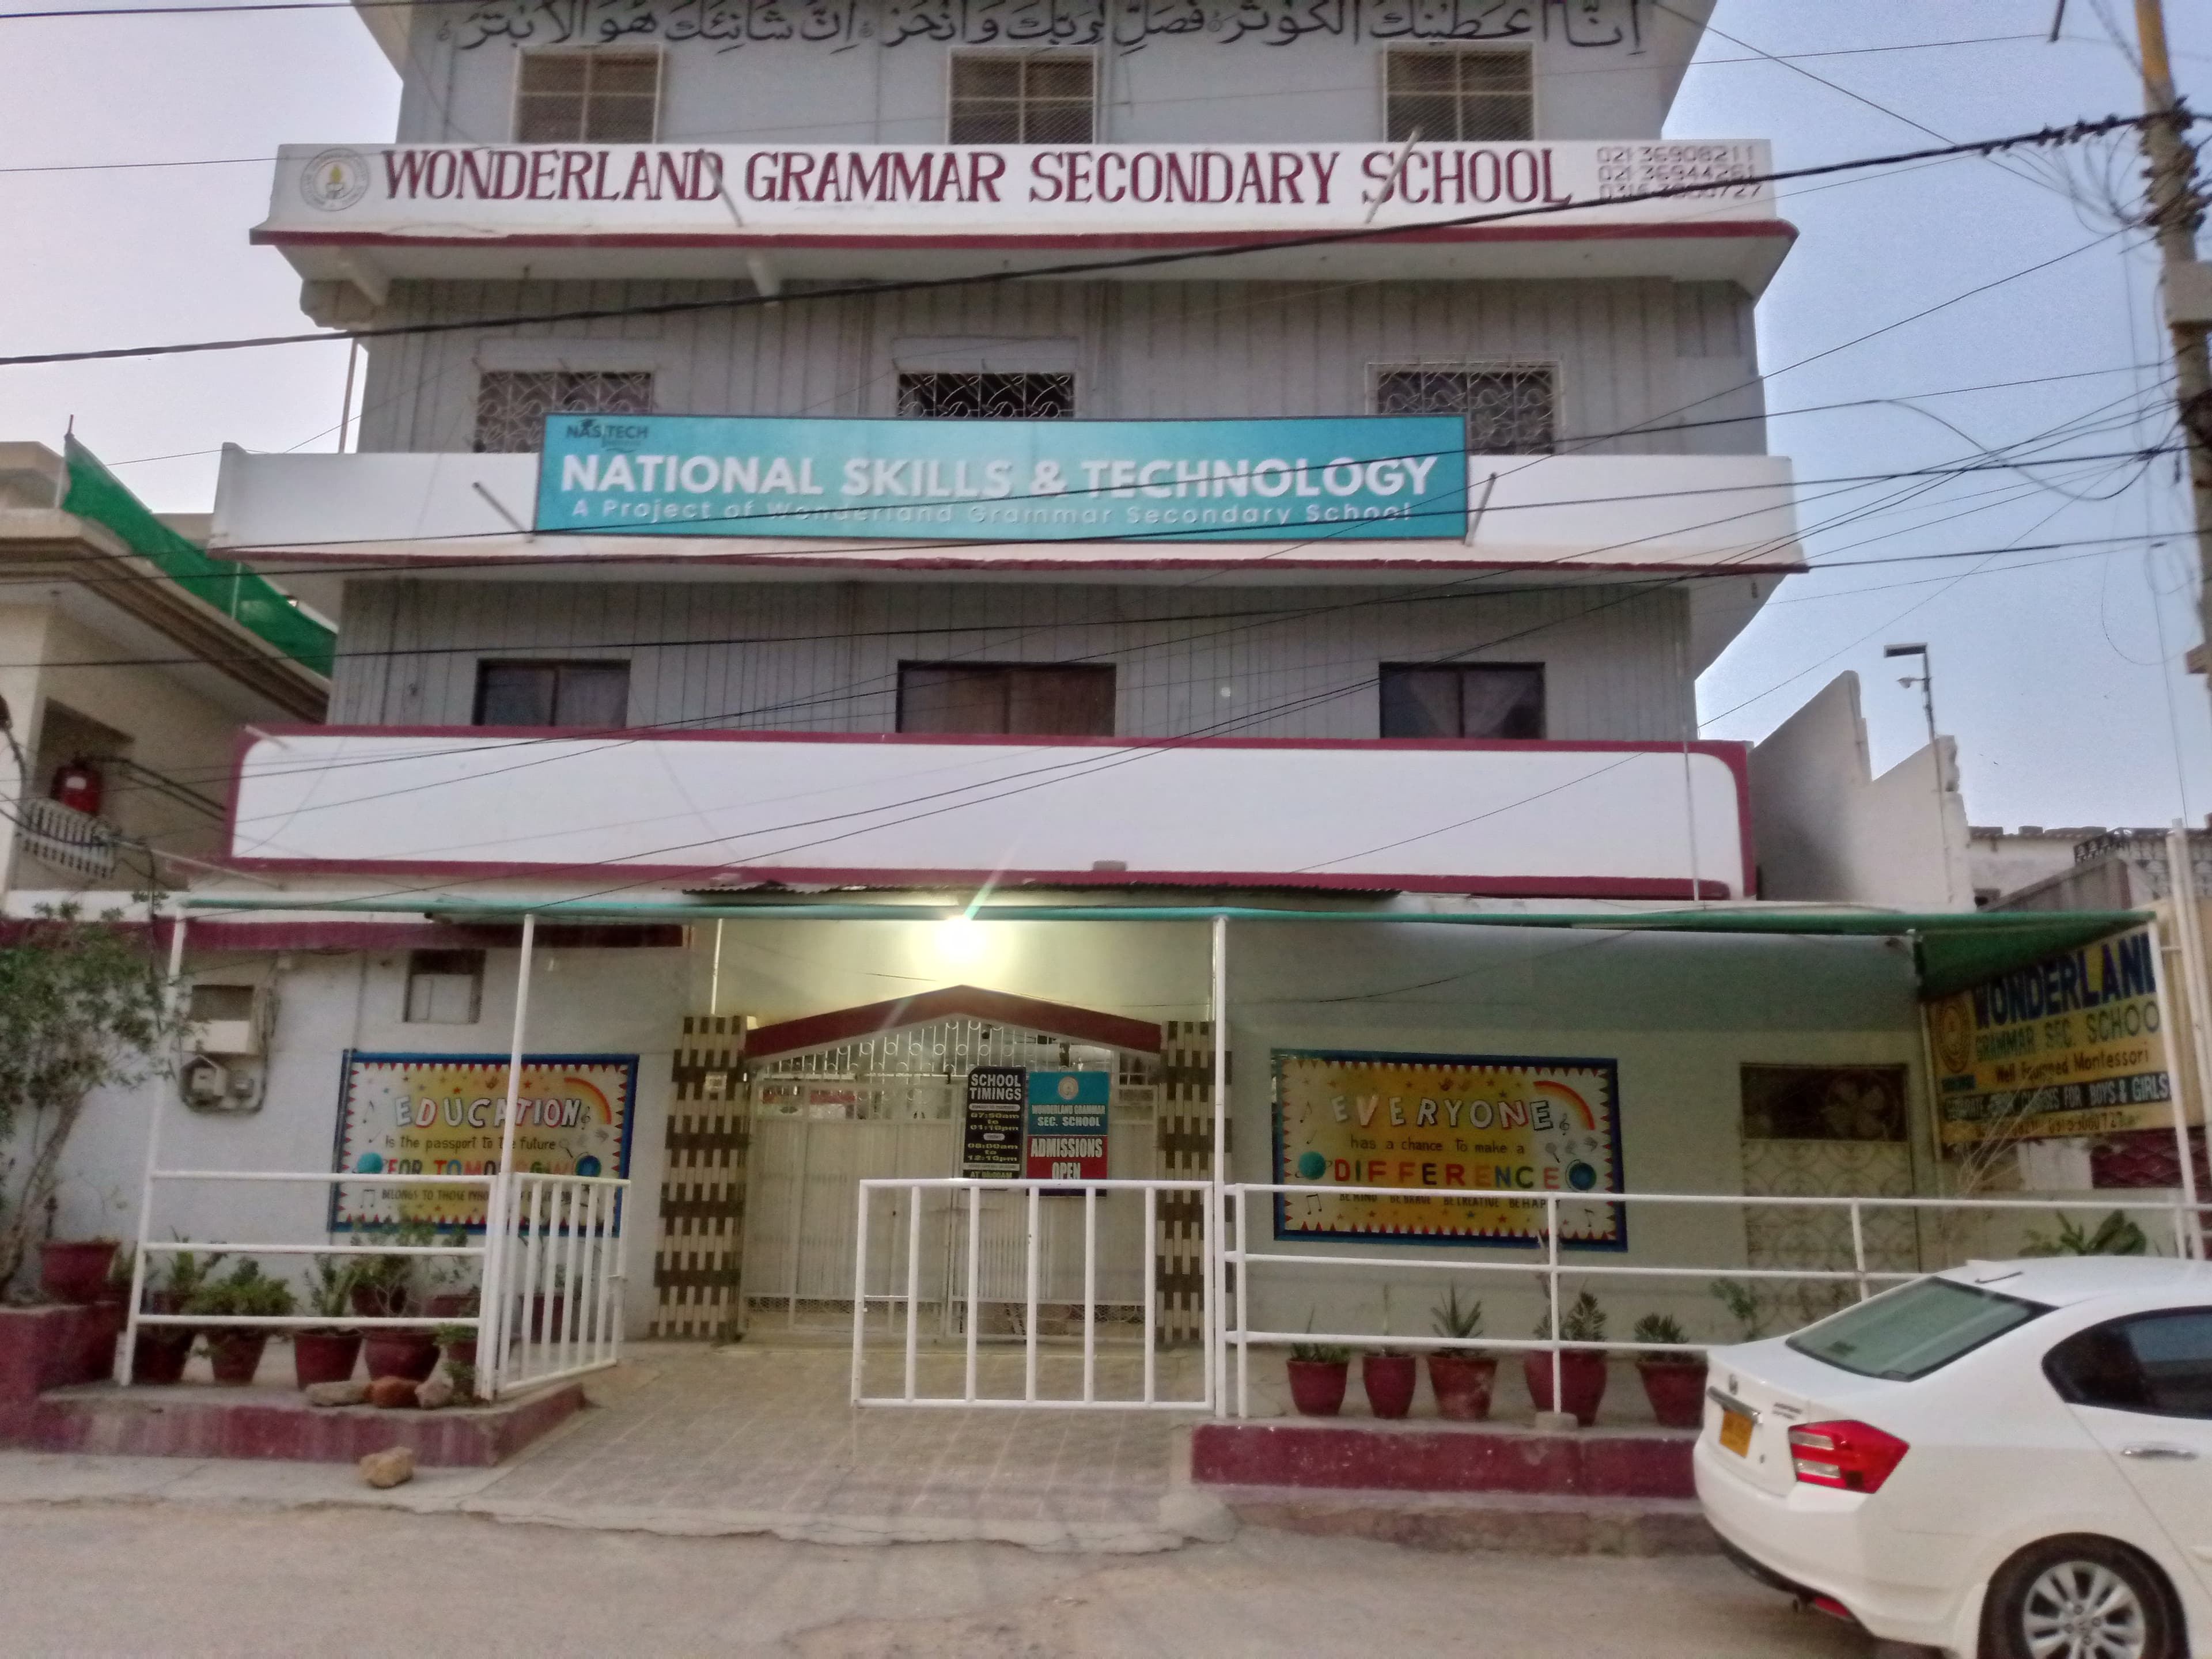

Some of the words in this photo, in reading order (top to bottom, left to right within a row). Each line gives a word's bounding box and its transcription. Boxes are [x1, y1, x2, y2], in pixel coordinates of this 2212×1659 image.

[383, 149, 724, 202] WONDERLAND
[745, 151, 1007, 203] GRAMMAR
[1029, 150, 1339, 204] SECONDARY
[1362, 148, 1571, 206] SCHOOL
[561, 454, 823, 495] NATIONAL
[840, 458, 1013, 499] SKILLS
[1029, 459, 1068, 498] &
[1081, 455, 1439, 499] TECHNOLOGY
[573, 499, 588, 517] A
[603, 498, 710, 524] Project
[724, 500, 752, 519] of
[768, 500, 963, 523] Wonderland
[969, 505, 1112, 524] Grammar
[1126, 503, 1291, 526] Secondary
[1305, 501, 1411, 525] School
[2075, 1041, 2149, 1071] Montessori
[971, 1074, 1021, 1087] SCHOOL
[2090, 1081, 2116, 1106] BOYS
[2133, 1072, 2169, 1101] GIRLS
[969, 1087, 1021, 1101] TIMINGS
[394, 1095, 582, 1128] EDUCATION
[1032, 1105, 1073, 1115] WONDERLAND
[1074, 1105, 1105, 1115] GRAMMAR
[1329, 1094, 1554, 1132] EVERYONE
[1037, 1116, 1058, 1127] SEC.
[1062, 1116, 1101, 1127] SCHOOL
[400, 1135, 420, 1149] the
[425, 1136, 476, 1154] passport
[482, 1136, 493, 1149] to
[499, 1136, 516, 1149] te
[520, 1136, 556, 1150] future
[1031, 1138, 1103, 1158] ADMISSIONS
[1350, 1134, 1376, 1150] has
[1385, 1139, 1395, 1150] a
[1401, 1135, 1443, 1152] chance
[1455, 1137, 1467, 1152] to
[1475, 1138, 1508, 1153] make
[1516, 1145, 1525, 1154] a
[1051, 1162, 1081, 1180] OPEN
[1334, 1158, 1560, 1190] DIFFERENCE
[423, 1190, 434, 1200] TO
[1457, 1196, 1499, 1208] CREATIVE
[1523, 1198, 1560, 1209] HAPY
